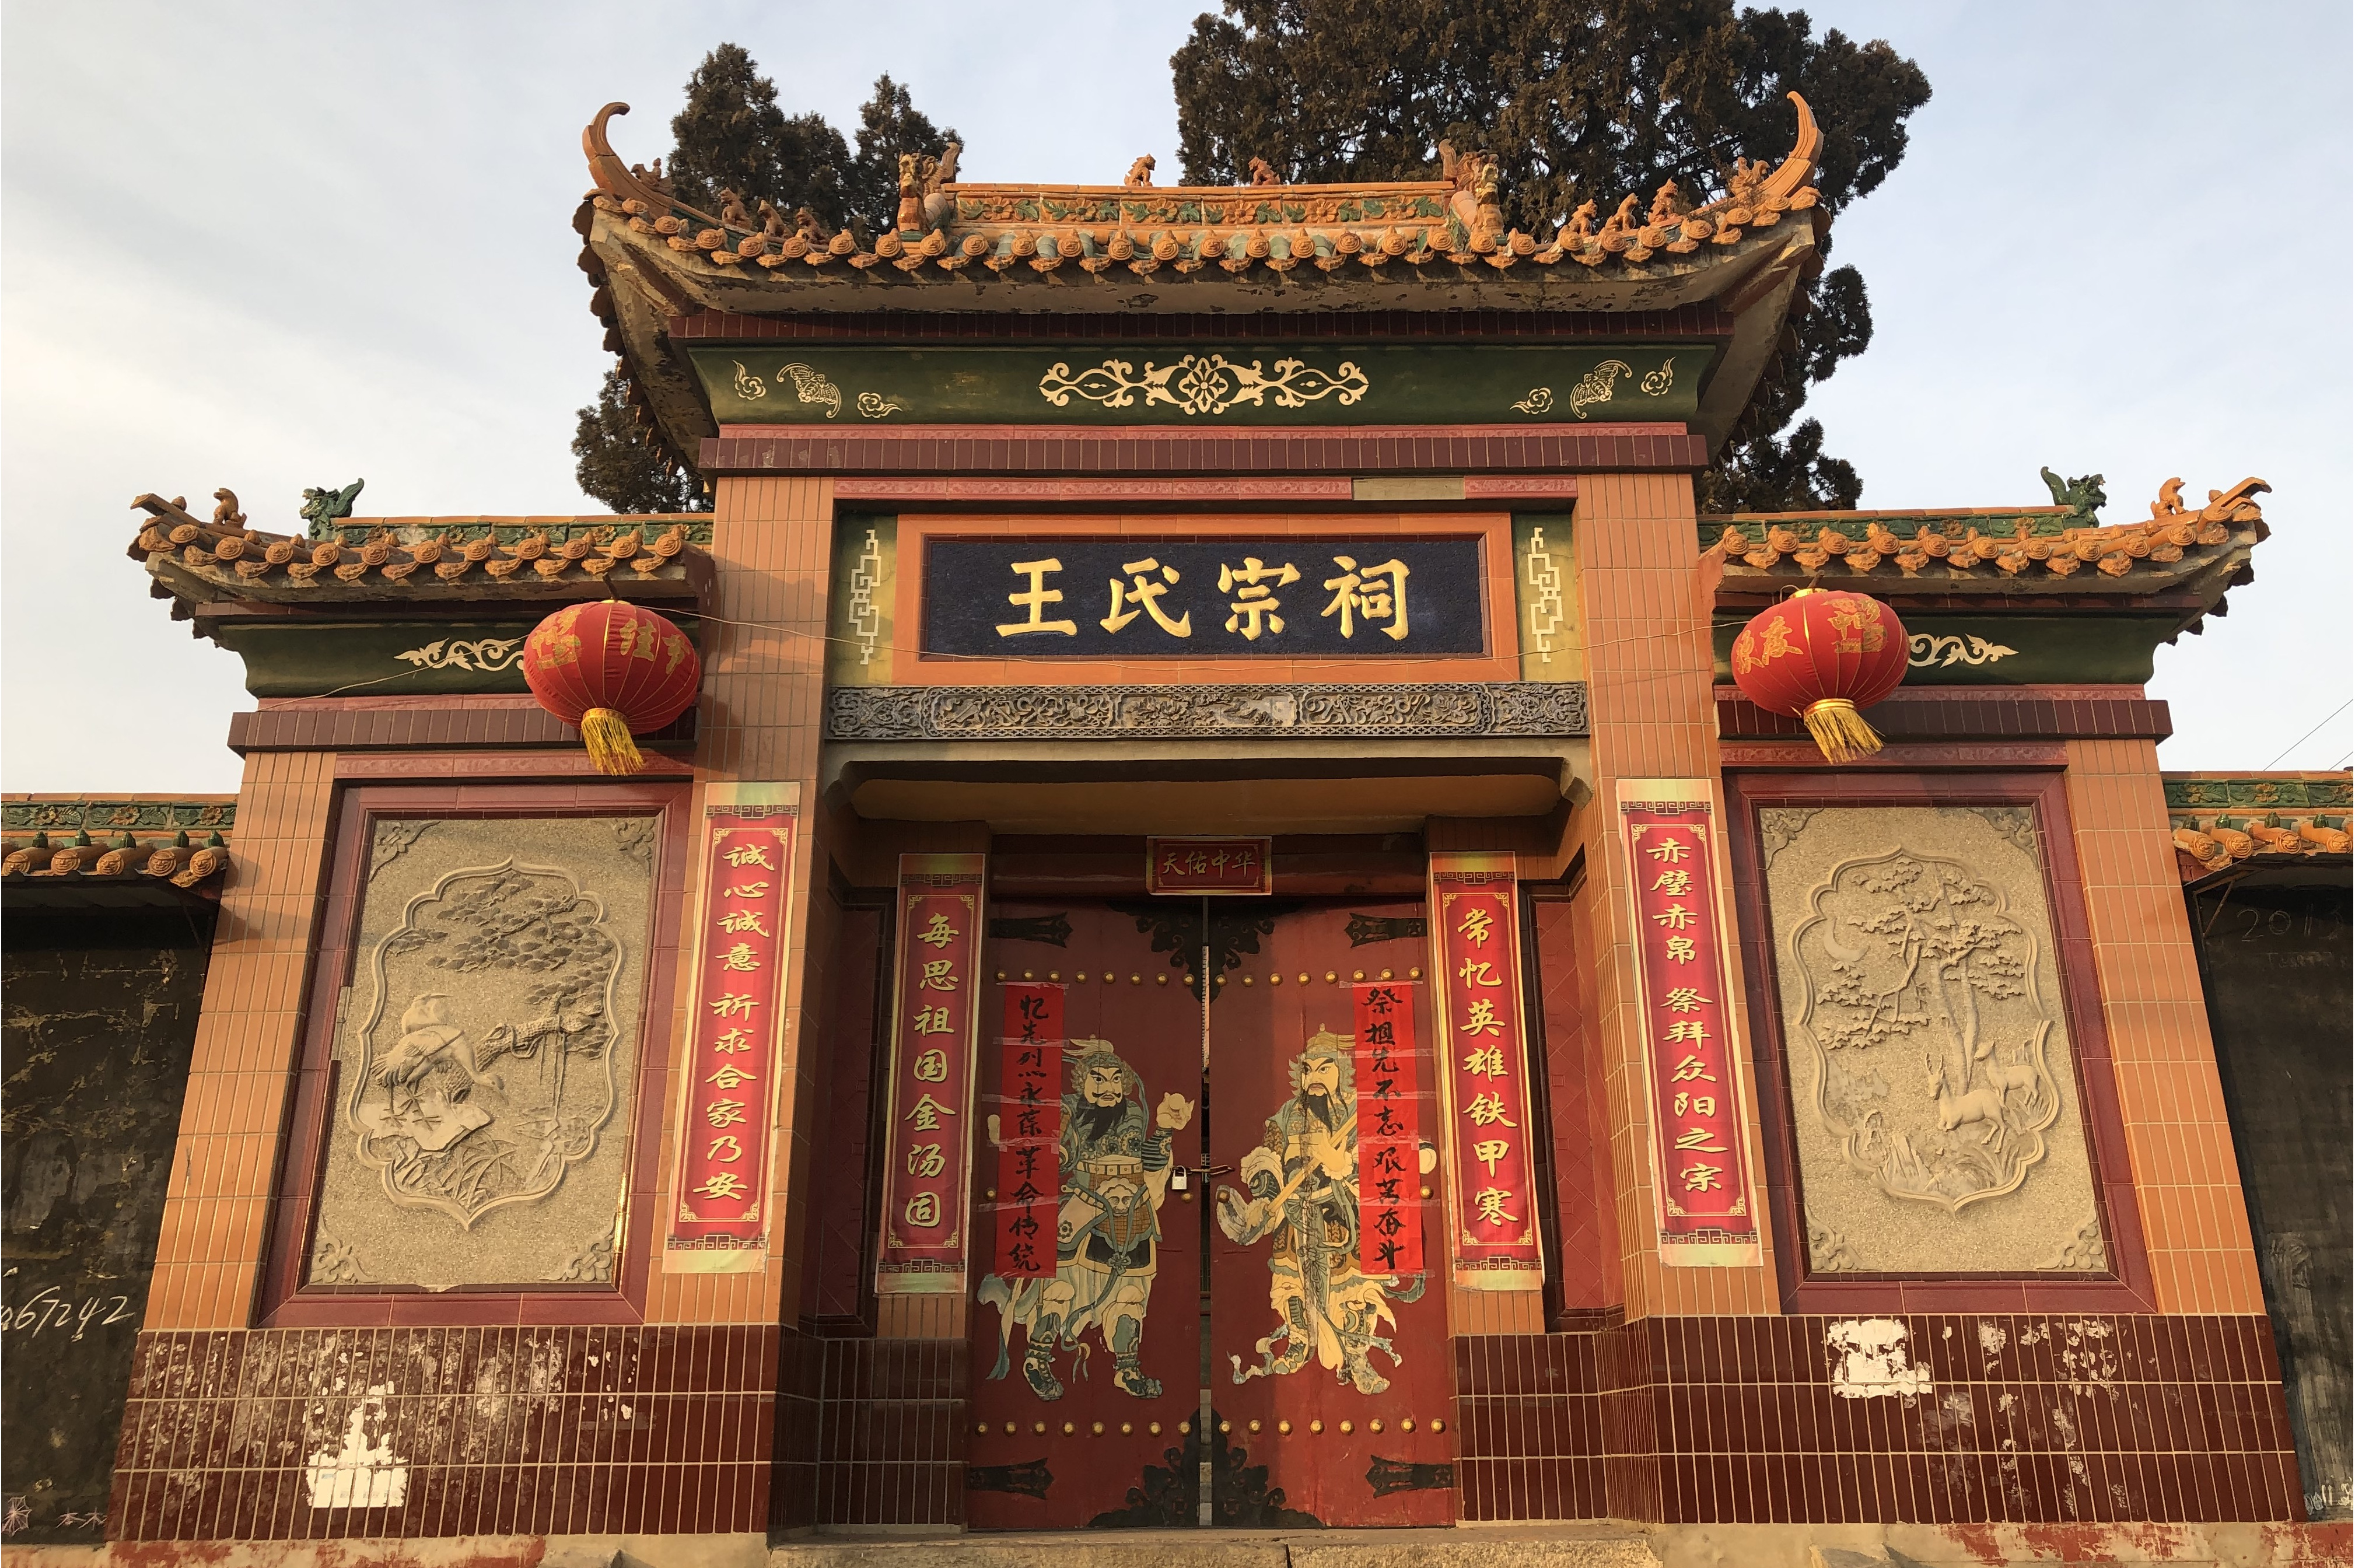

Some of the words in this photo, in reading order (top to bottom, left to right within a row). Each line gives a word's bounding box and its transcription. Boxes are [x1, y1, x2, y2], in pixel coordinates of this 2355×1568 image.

[995, 555, 1409, 641] 王氏宗祠
[1161, 849, 1255, 878] 天佑中华
[904, 913, 959, 1227] 每思祖国金汤固
[1009, 995, 1049, 1272] 忆先烈永葆革命传统
[1457, 908, 1518, 1226] 常忆英雄铁甲寒
